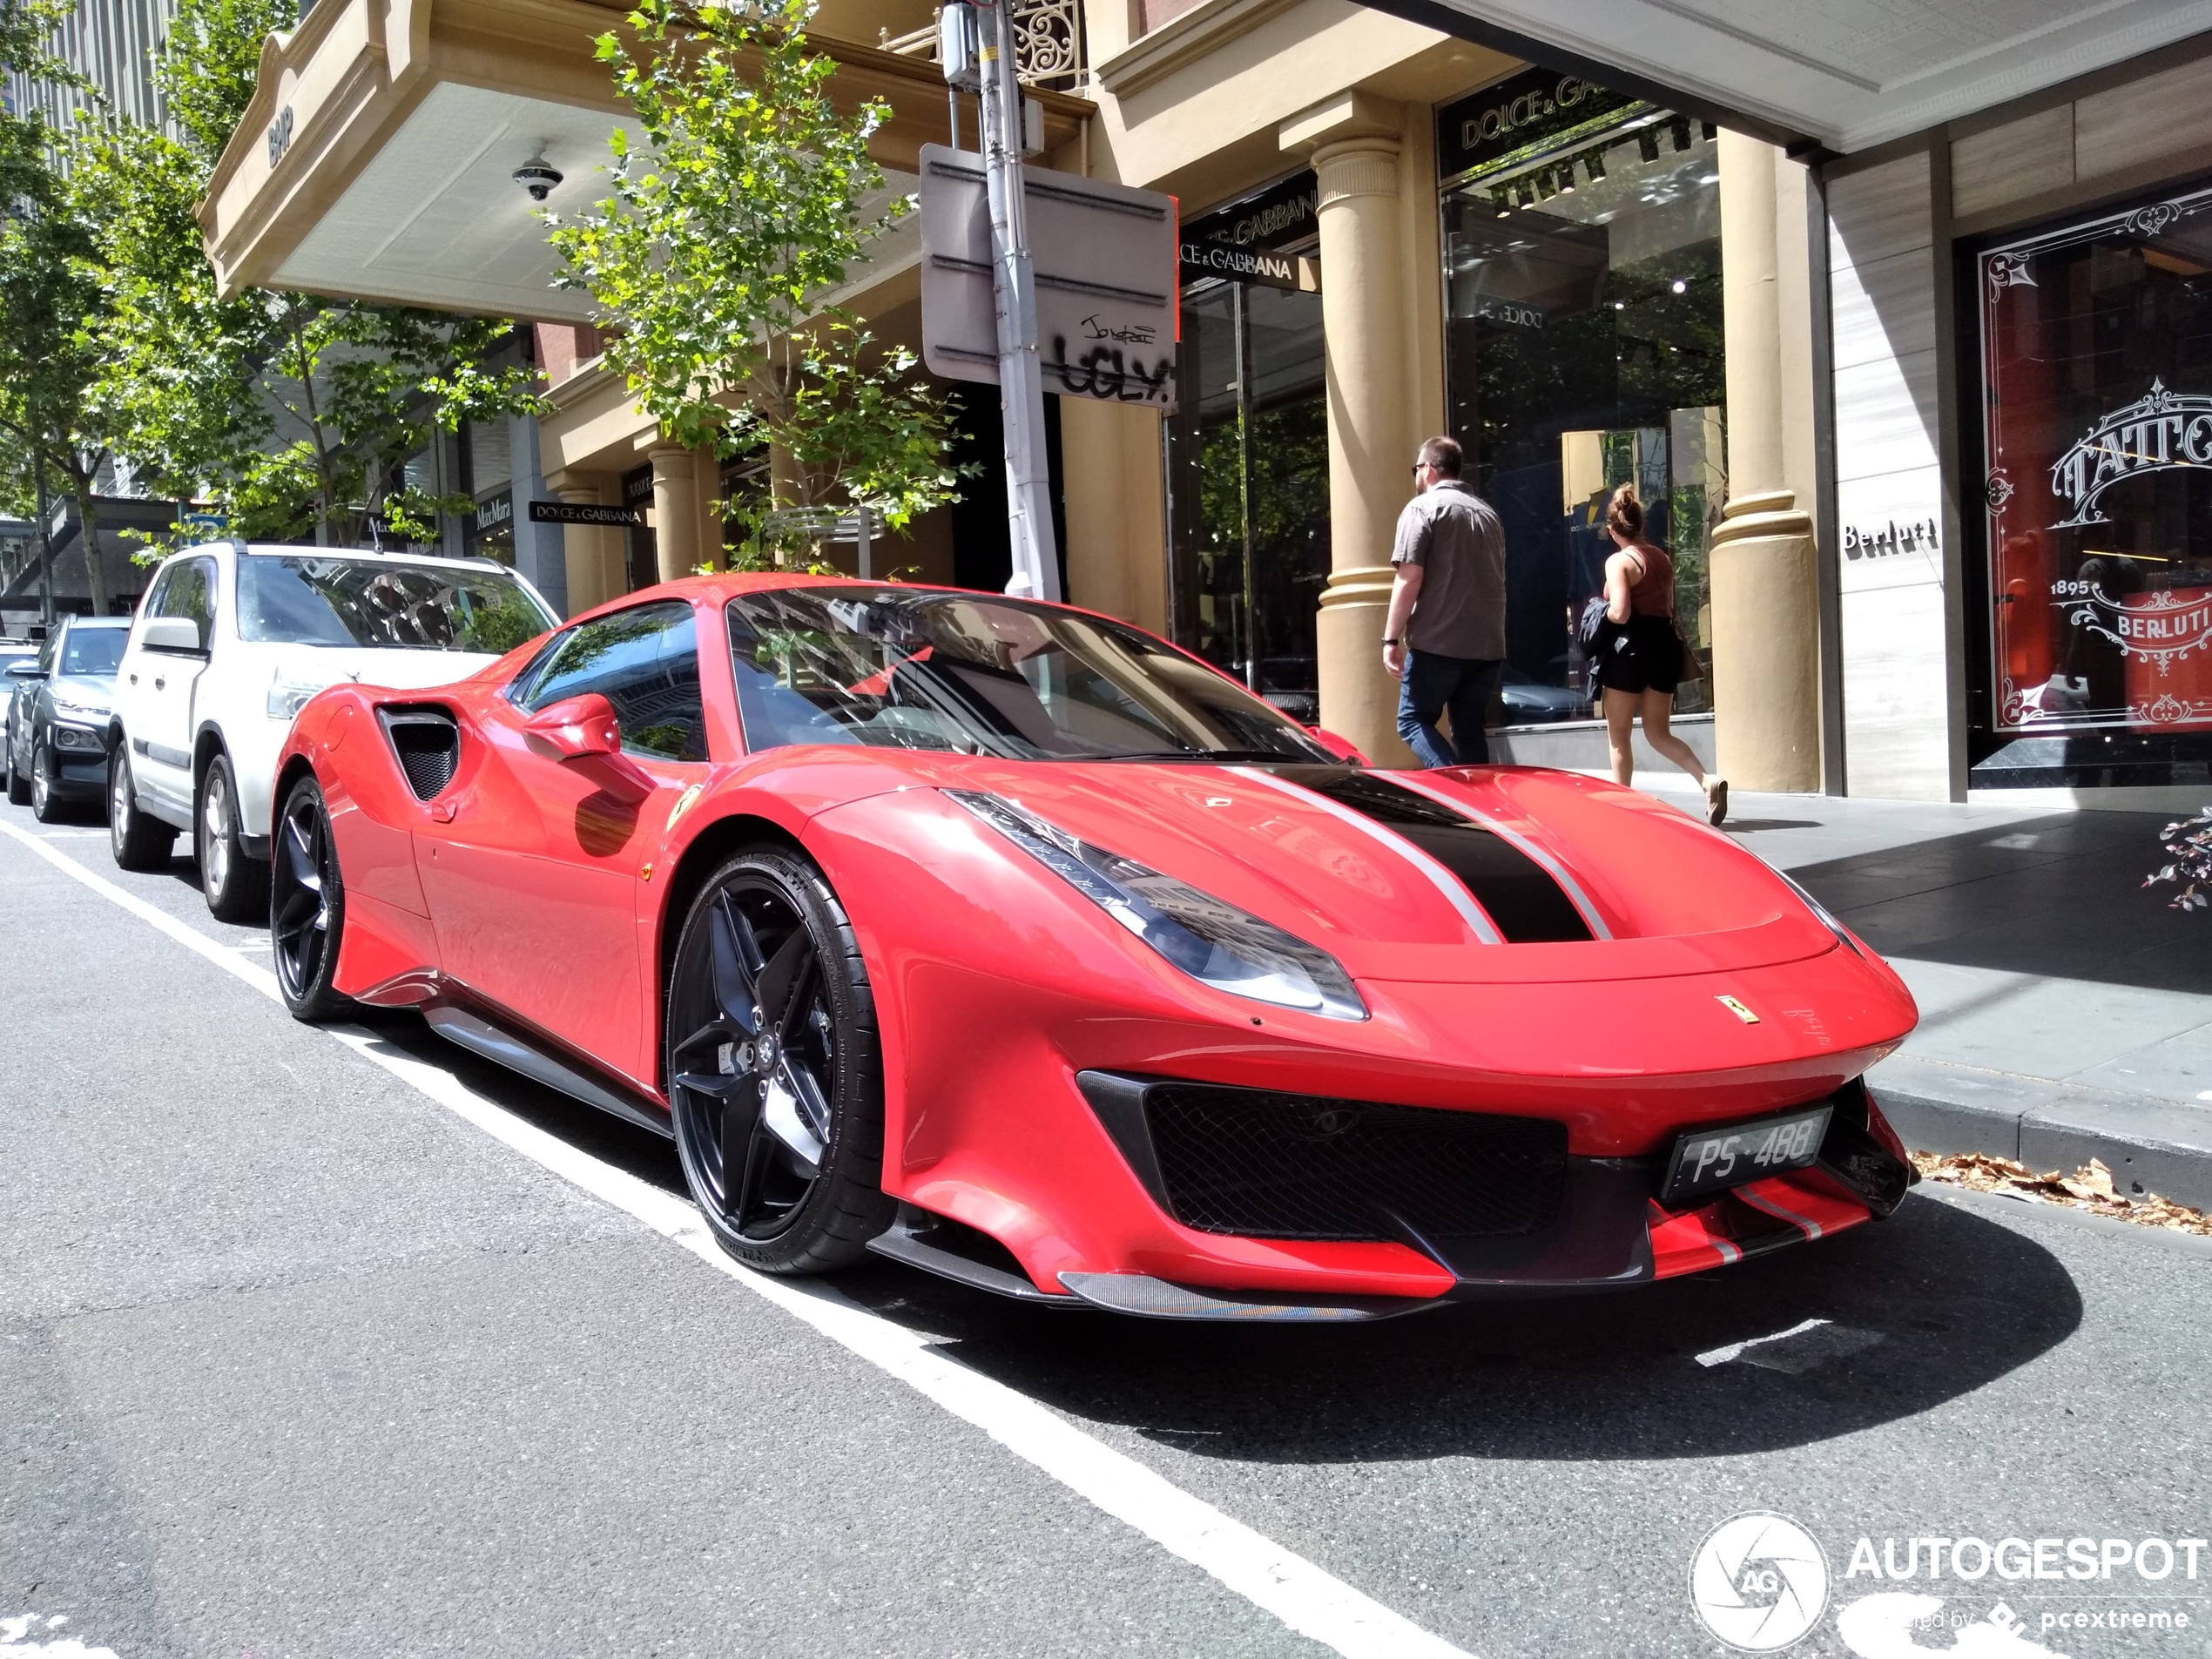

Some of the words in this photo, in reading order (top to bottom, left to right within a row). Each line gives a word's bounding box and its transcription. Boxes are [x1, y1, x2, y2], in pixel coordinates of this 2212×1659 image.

[268, 105, 293, 169] BHP
[1461, 90, 1542, 150] DOLCE
[1543, 98, 1556, 115] &
[1233, 189, 1318, 245] GABBAN
[1202, 255, 1210, 266] &
[1211, 248, 1292, 280] GABBANA
[476, 499, 510, 530] MaxMara
[536, 506, 575, 519] DOCE
[582, 509, 642, 523] GABBANA
[1844, 518, 1938, 554] Berluti
[2050, 579, 2088, 596] 1895
[2118, 607, 2209, 638] BERLUTI
[1754, 1120, 1814, 1167] 488
